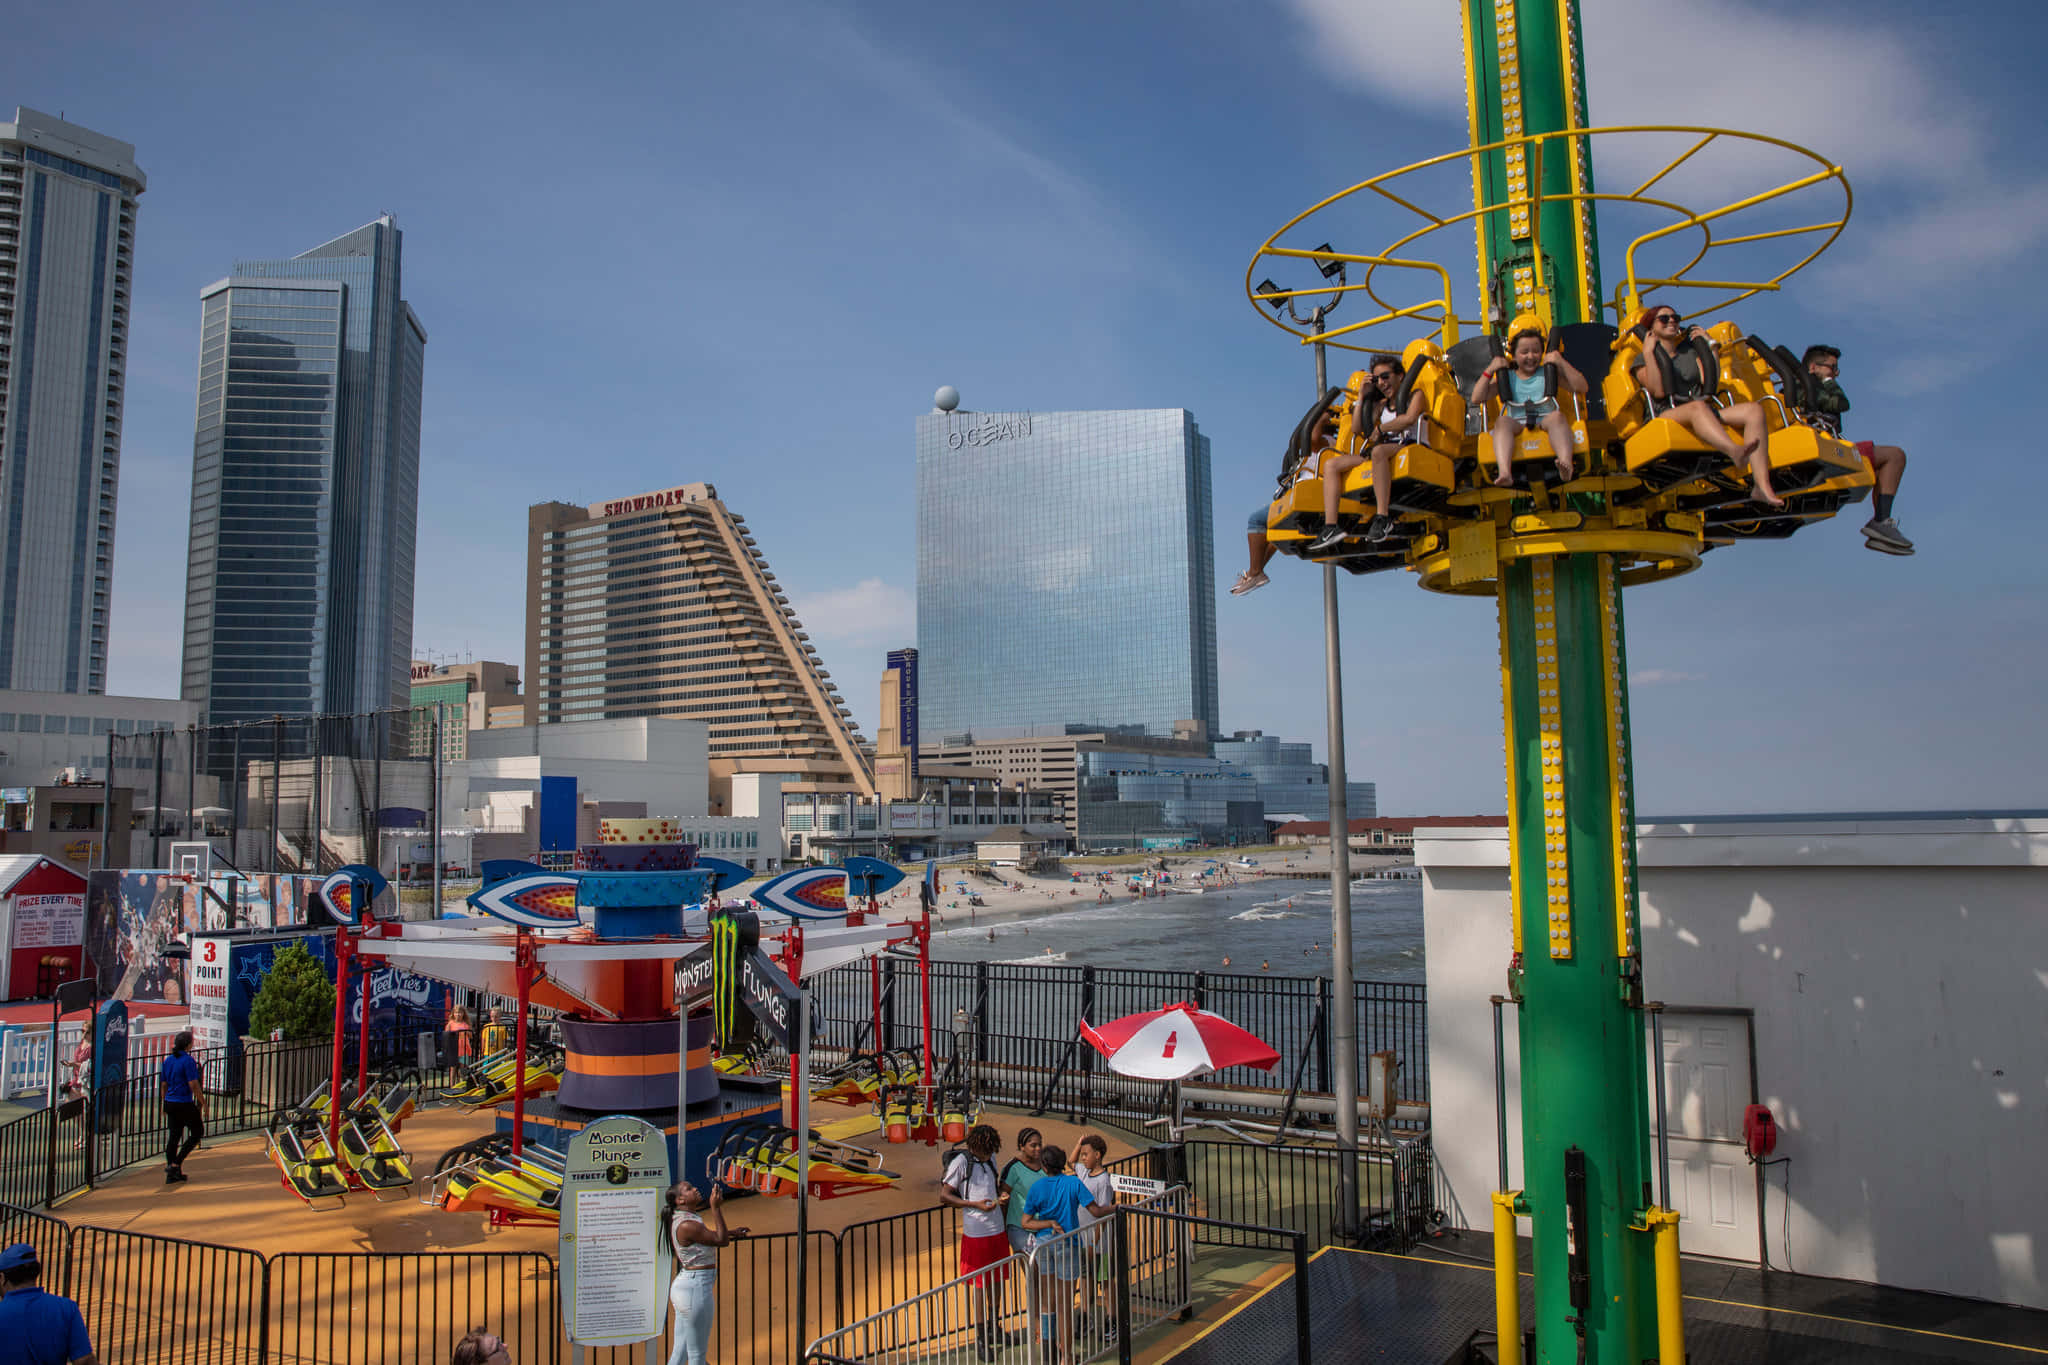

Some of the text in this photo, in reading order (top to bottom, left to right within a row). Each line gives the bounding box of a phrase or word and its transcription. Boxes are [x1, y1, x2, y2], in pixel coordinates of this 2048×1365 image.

[948, 415, 1032, 450] OCEAN
[1574, 429, 1585, 444] 8
[1398, 454, 1407, 469] 7
[603, 489, 685, 517] SHOWBOAT
[18, 895, 82, 909] PRIZE EVERY TIME
[203, 941, 217, 963] 3
[196, 965, 223, 979] POINT
[193, 983, 226, 999] CHALLENGE
[743, 959, 787, 1030] PLUNGE
[588, 1131, 646, 1146] Monster
[592, 1148, 643, 1166] Plunge
[1119, 1177, 1155, 1189] ENTRANCE
